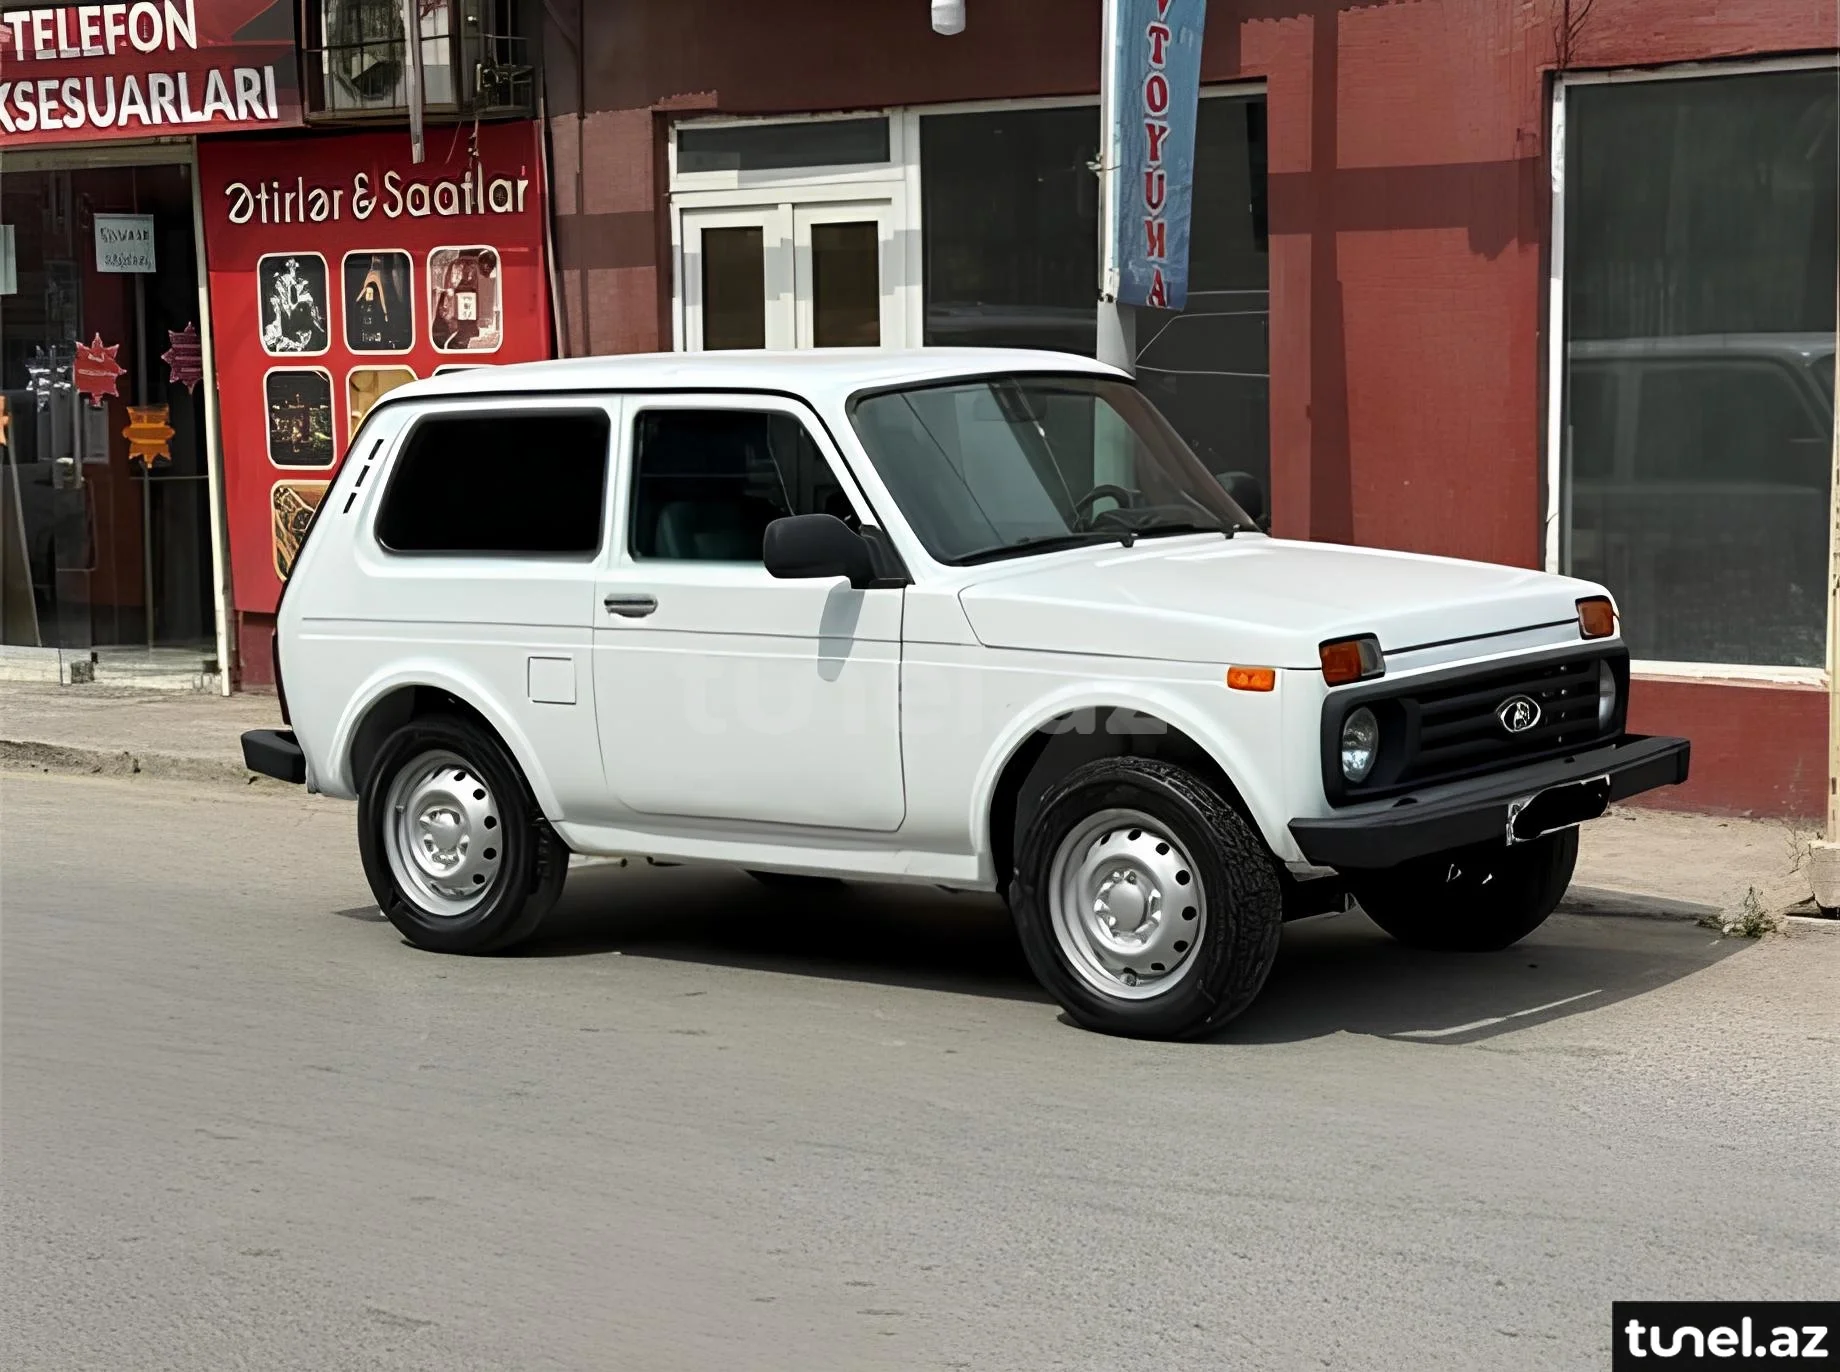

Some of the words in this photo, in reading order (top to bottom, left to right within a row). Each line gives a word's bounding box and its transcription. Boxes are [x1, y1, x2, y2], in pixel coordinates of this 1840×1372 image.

[3, 0, 197, 61] TELEFON
[352, 172, 378, 220] &
[382, 170, 529, 218] Saatlar
